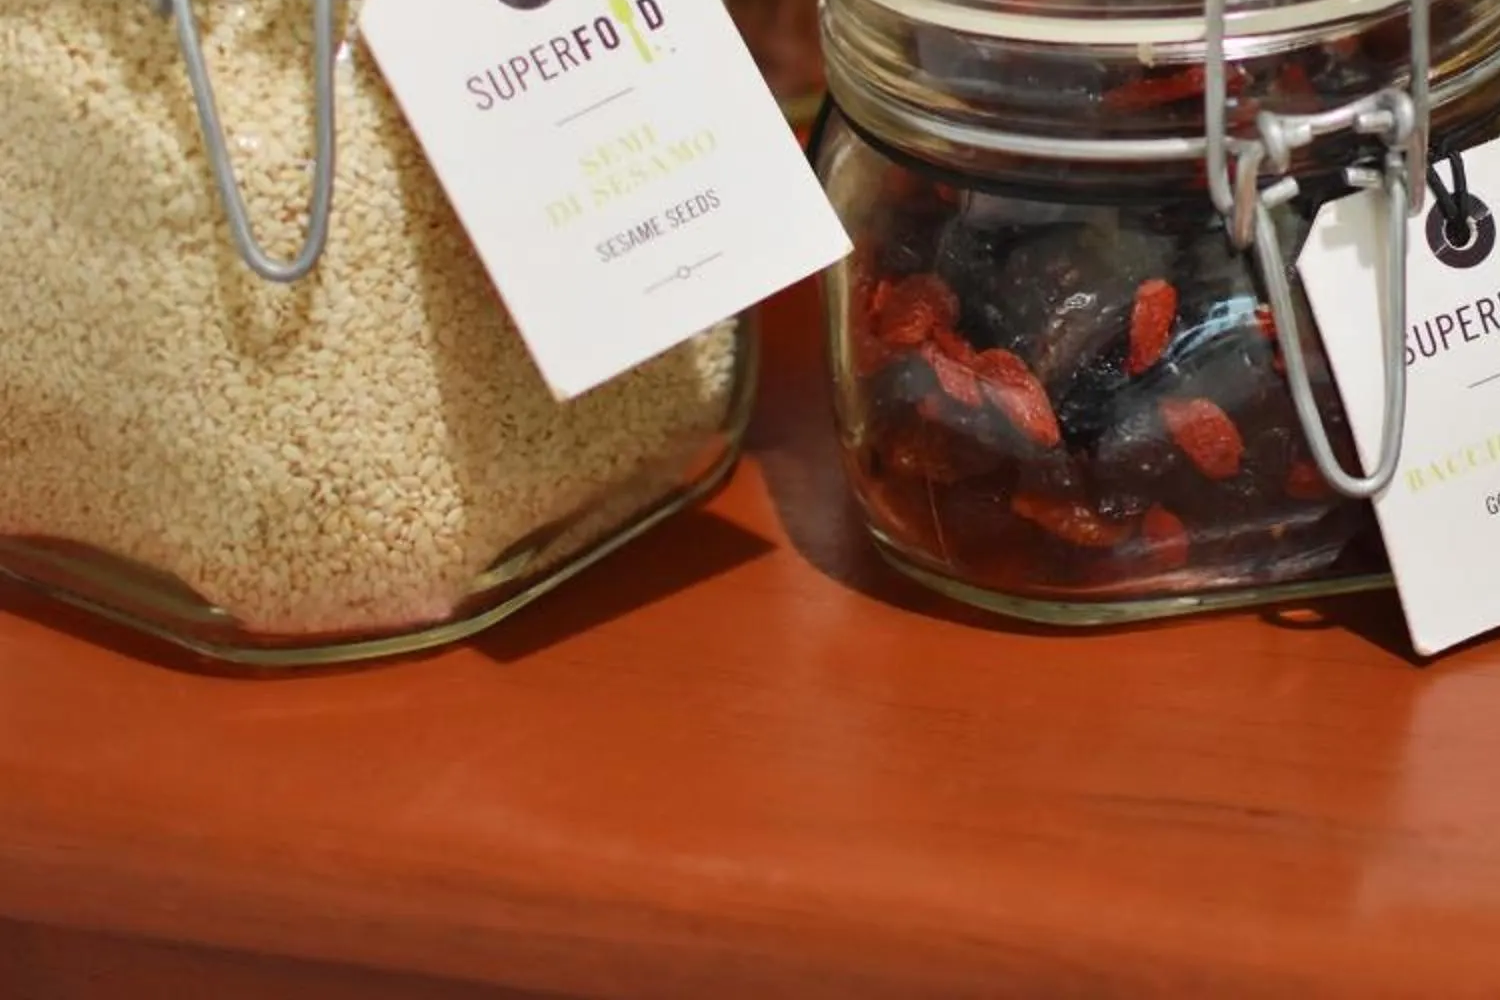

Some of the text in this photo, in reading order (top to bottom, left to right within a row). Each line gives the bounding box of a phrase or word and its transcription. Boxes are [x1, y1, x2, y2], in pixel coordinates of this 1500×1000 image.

[545, 128, 718, 228] DI SESAMO
[596, 188, 721, 263] SESAME SEEDS
